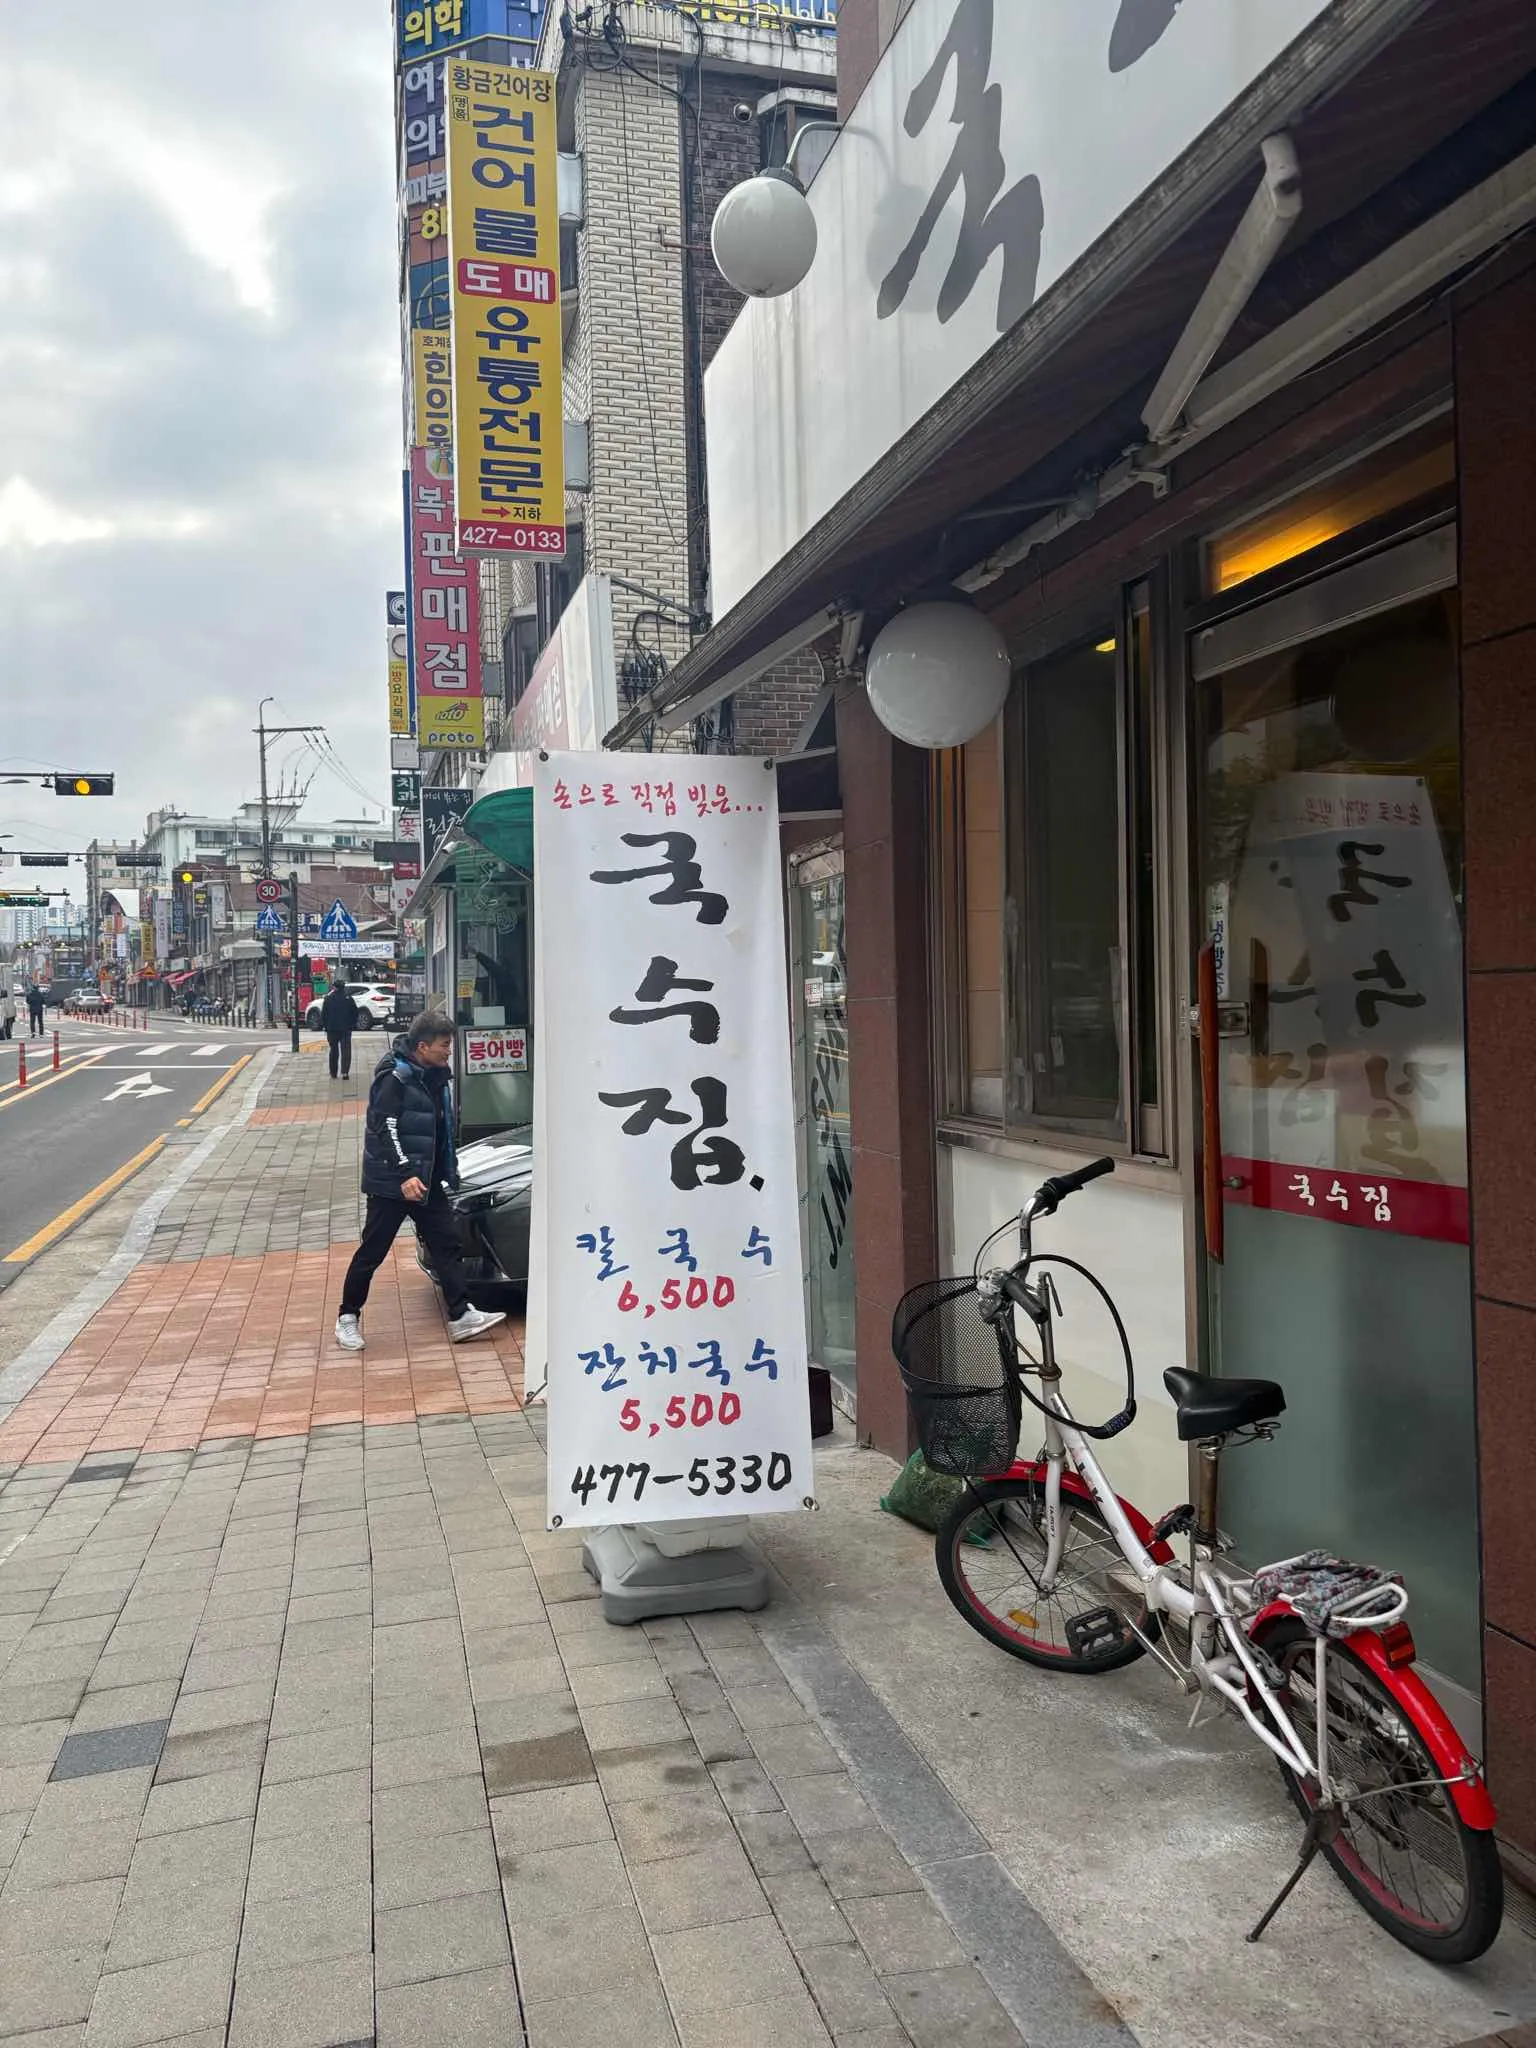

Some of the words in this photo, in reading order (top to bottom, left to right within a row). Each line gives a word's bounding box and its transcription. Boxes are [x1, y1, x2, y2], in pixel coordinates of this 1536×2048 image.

[453, 66, 551, 102] 황금건어장
[471, 103, 538, 258] 건어물
[464, 262, 549, 301] 도매
[422, 335, 450, 348] 호계
[476, 306, 544, 504] 유통전문
[512, 505, 541, 521] 지하
[462, 526, 561, 550] 427-0133
[428, 732, 475, 745] proto
[396, 777, 418, 802] 치과
[552, 778, 620, 810] 손으로
[631, 781, 677, 817] 직접
[262, 886, 276, 897] 30
[469, 1040, 525, 1061] 붕어빵
[1288, 1174, 1392, 1222] 국수집
[617, 1275, 736, 1318] 6,500
[578, 1338, 778, 1392] 잔치국수
[618, 1391, 742, 1438] 5,500
[571, 1451, 792, 1506] 477-5330
